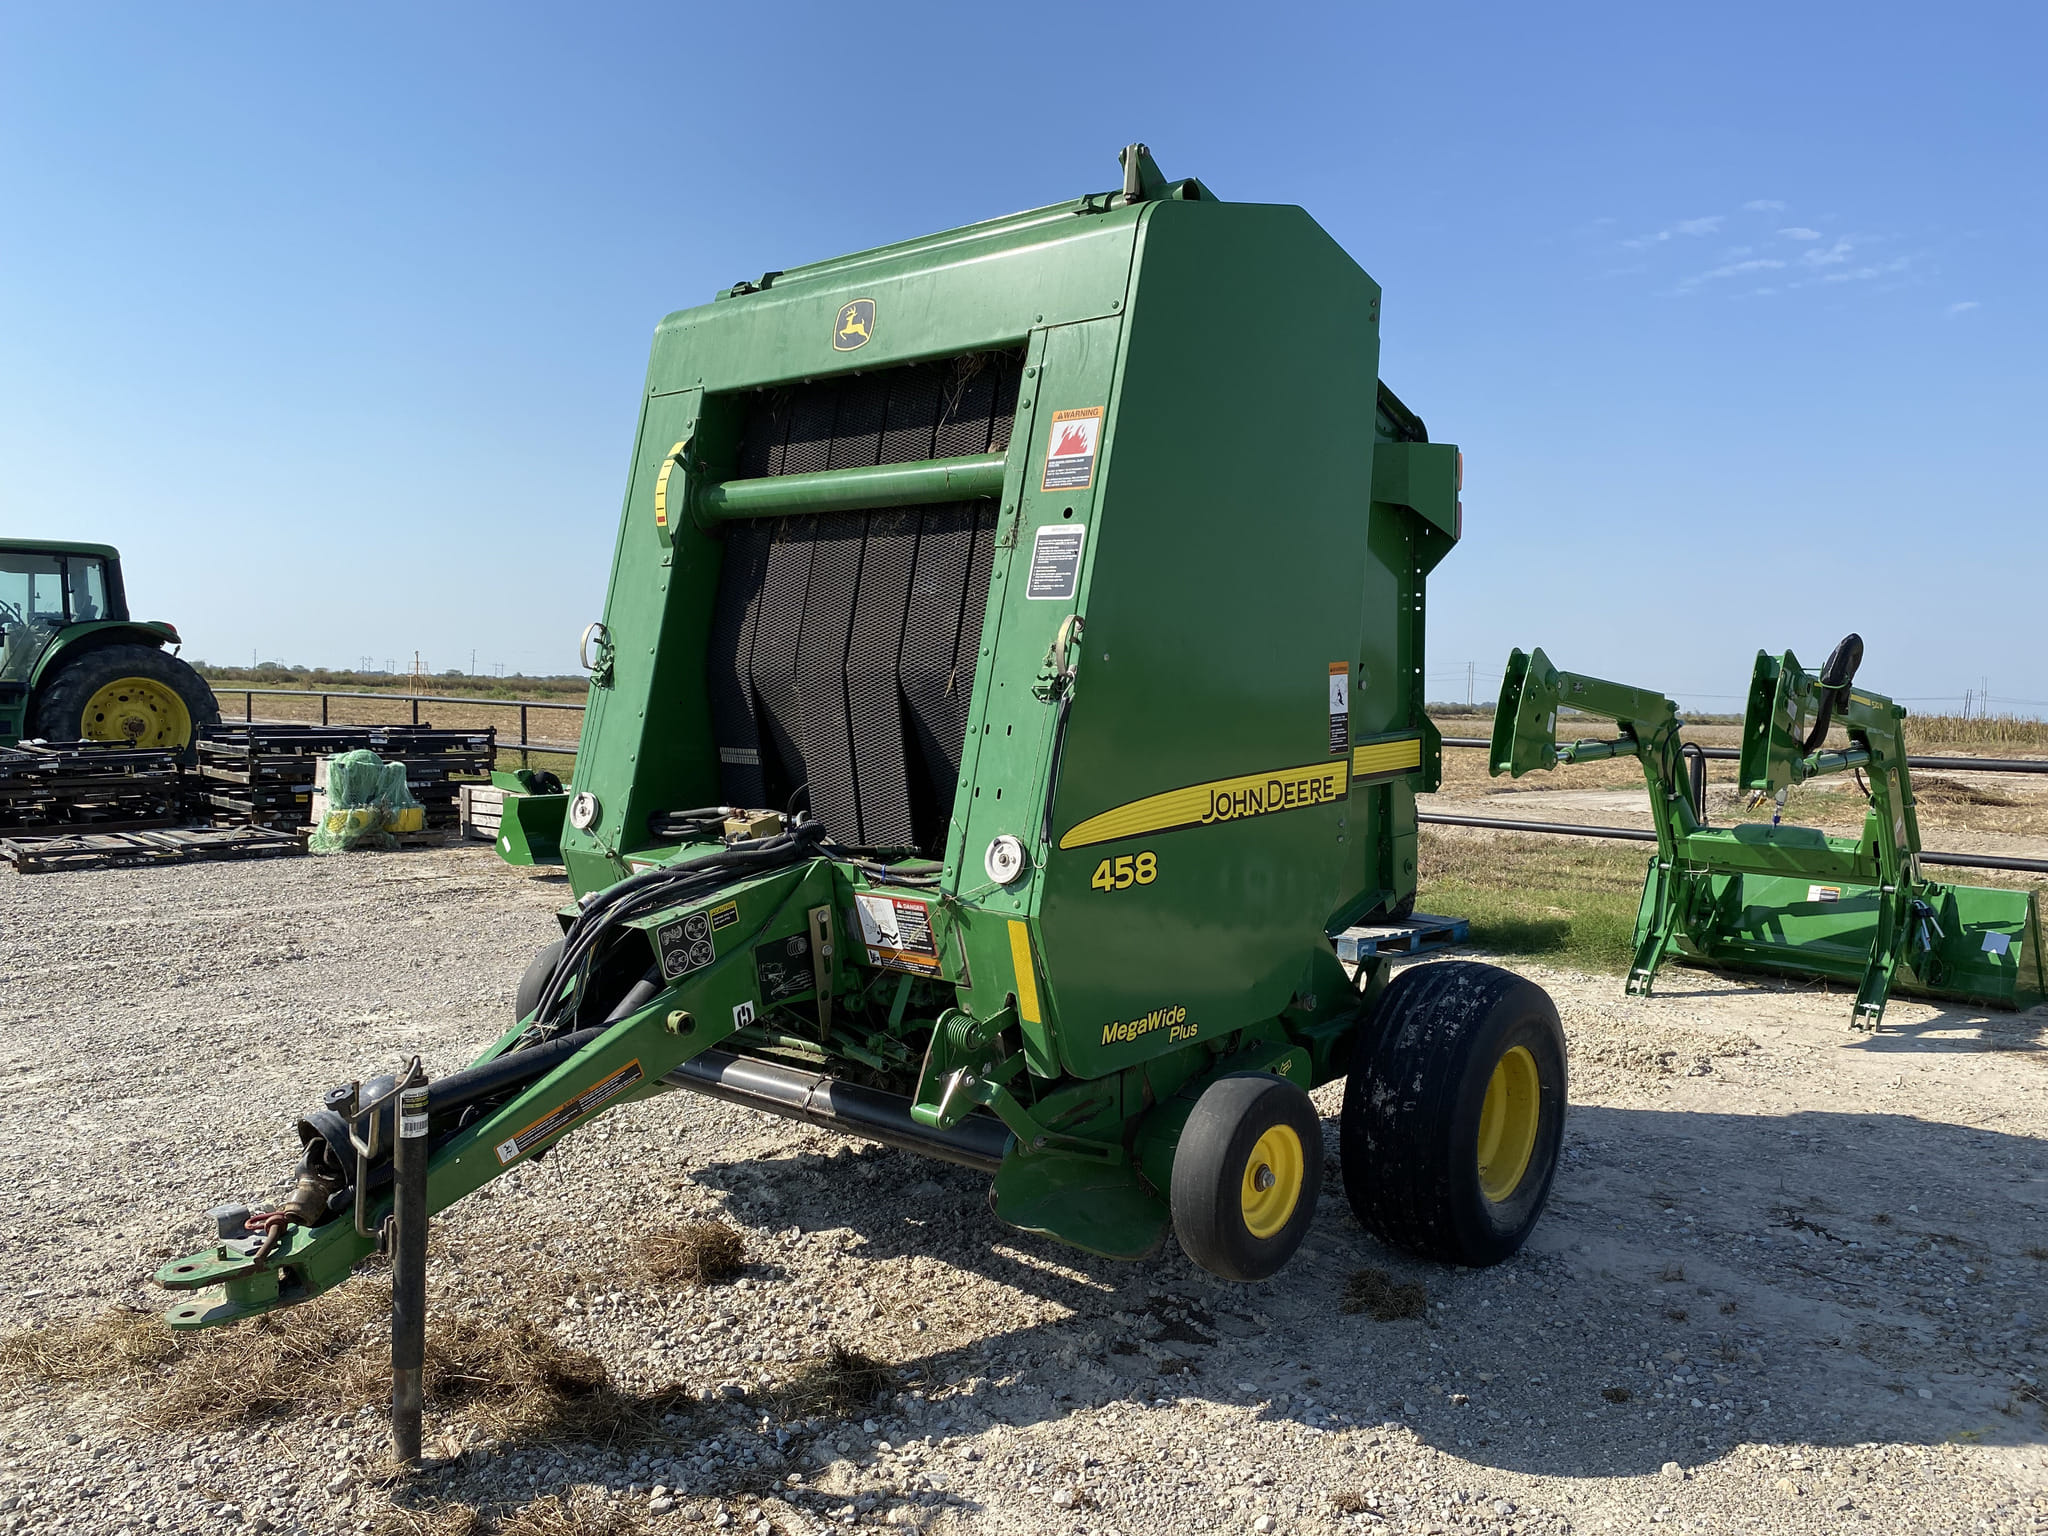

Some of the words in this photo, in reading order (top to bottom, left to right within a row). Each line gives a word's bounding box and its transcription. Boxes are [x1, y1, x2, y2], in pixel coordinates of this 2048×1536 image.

[1063, 408, 1099, 419] WARNING
[1201, 788, 1264, 821] JOHN
[1266, 775, 1335, 810] DEERE
[1091, 851, 1157, 892] 458
[1101, 1004, 1187, 1046] MegaWide
[1168, 1023, 1199, 1044] Plus
